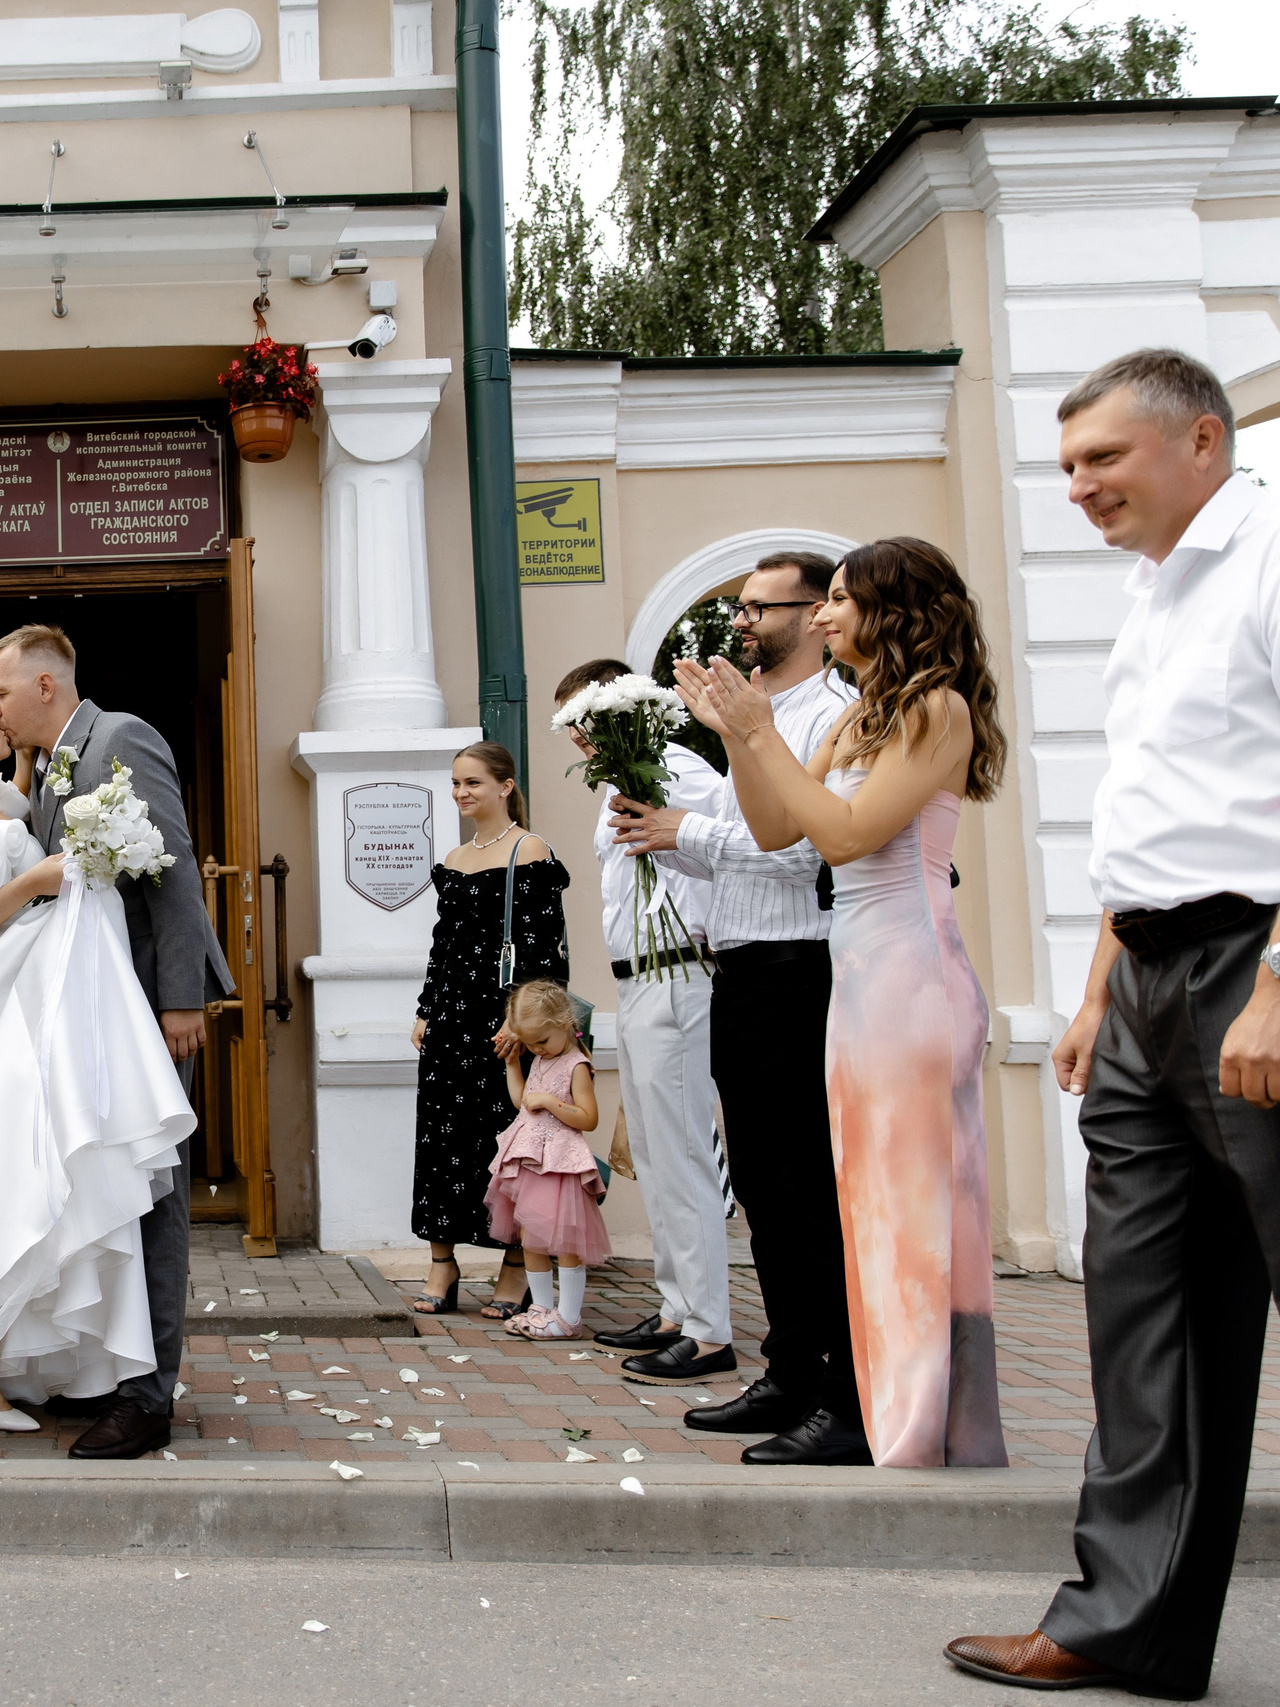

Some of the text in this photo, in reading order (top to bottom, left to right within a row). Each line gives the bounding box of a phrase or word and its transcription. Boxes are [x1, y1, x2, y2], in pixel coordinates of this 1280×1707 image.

[87, 429, 196, 442] Витебский городской
[76, 442, 207, 455] исполнительный комитет
[97, 458, 181, 468] Администрация
[67, 468, 211, 482] Железнодорожного района
[112, 482, 168, 492] г.Витебска
[10, 501, 46, 516] АКТАЎ
[70, 498, 209, 515] ОТДЕЛ ЗАПИСИ АКТОВ
[91, 515, 189, 530] ГРАЖДАНСКОГО
[103, 531, 178, 544] СОСТОЯНИЯ
[522, 539, 595, 550] ТЕРРИТОРИИ
[525, 552, 573, 564] ВЕДЁТСЯ
[520, 565, 600, 577] ЕОНАБЛЮДЕНИЕ
[364, 843, 414, 851] БУДЫНАК
